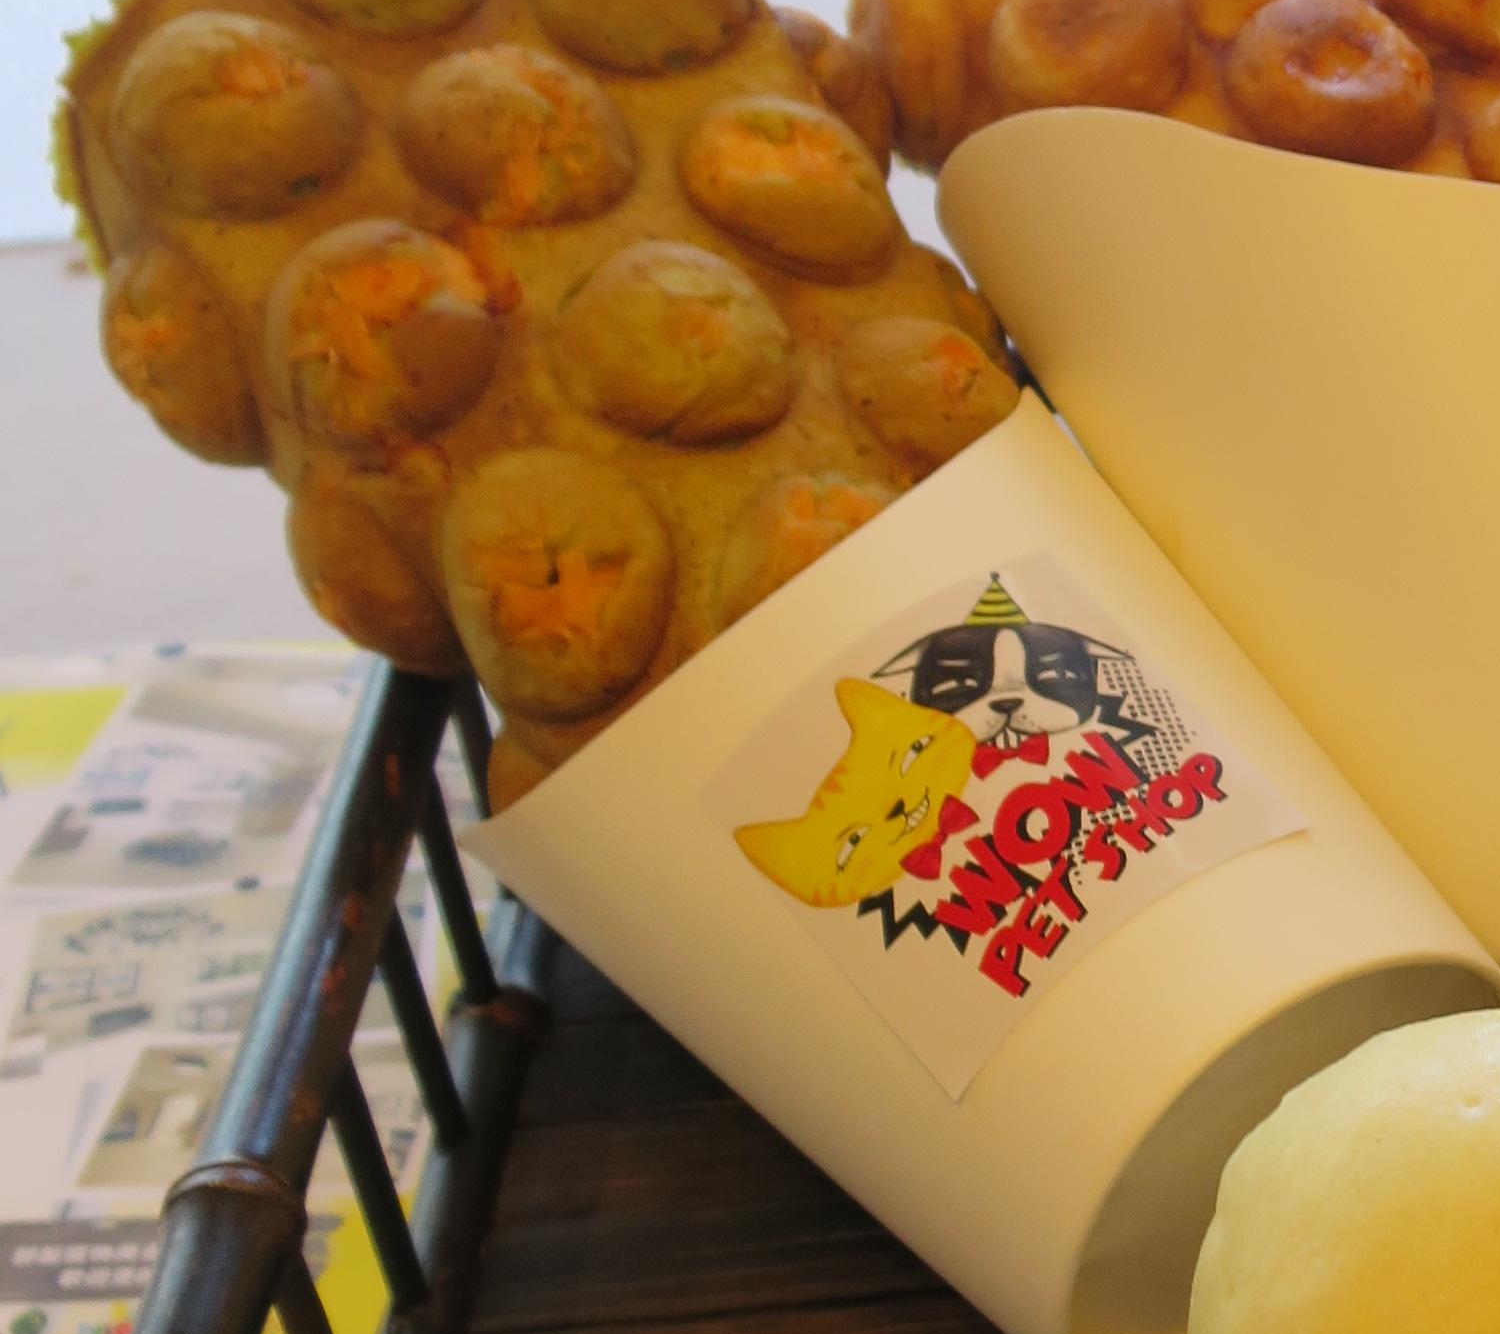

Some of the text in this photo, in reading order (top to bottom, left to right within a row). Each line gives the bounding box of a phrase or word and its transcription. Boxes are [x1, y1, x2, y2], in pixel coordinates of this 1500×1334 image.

[934, 730, 1151, 937] WOW
[978, 751, 1229, 998] PET SHOP
